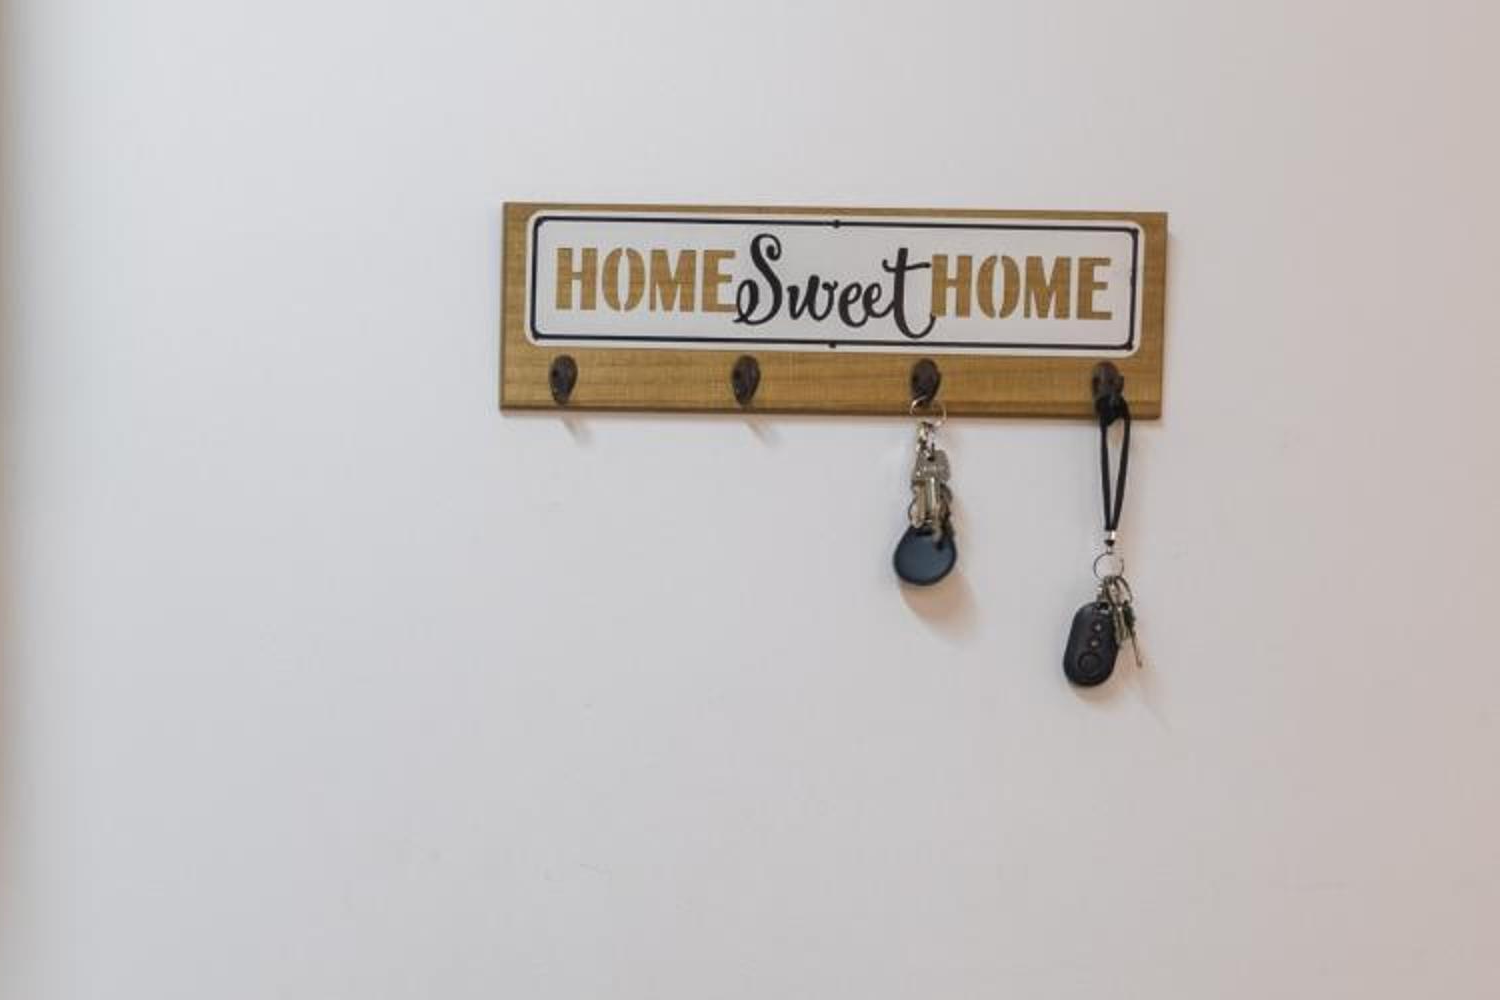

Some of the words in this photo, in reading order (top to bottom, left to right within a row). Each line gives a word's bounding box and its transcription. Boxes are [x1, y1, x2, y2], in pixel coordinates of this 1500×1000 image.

[554, 246, 737, 314] HOME
[731, 233, 936, 338] Sweet
[931, 253, 1113, 321] HOME
